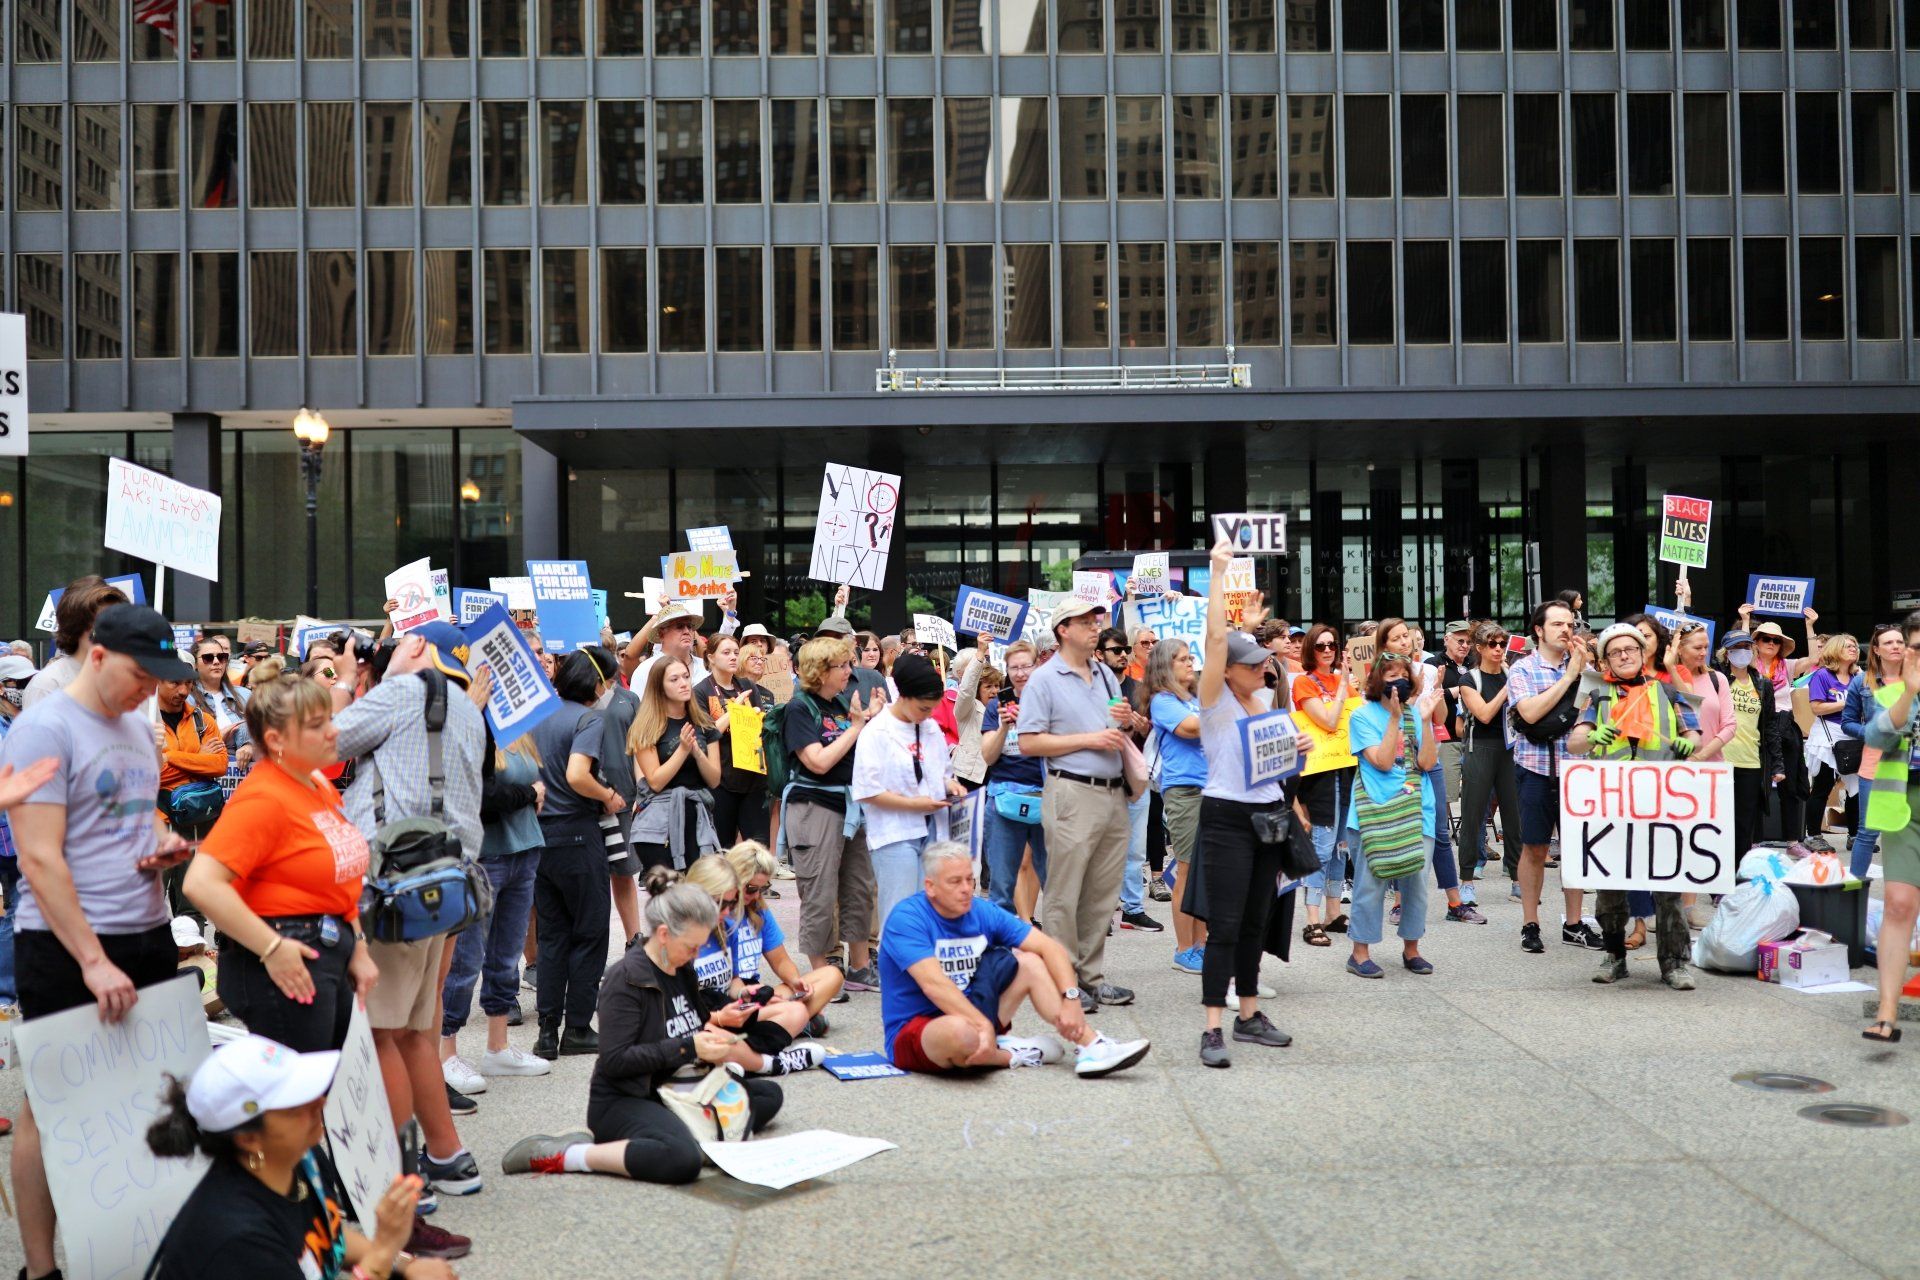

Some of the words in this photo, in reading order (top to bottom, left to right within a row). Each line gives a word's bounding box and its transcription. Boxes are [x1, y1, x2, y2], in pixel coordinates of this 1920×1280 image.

[118, 465, 163, 492] TURN
[160, 499, 200, 521] INTO
[1666, 499, 1708, 517] BLACK
[1218, 517, 1282, 549] VOTE
[1664, 518, 1708, 542] LIVES
[1662, 543, 1705, 564] MATTER
[532, 563, 578, 575] MARCH
[674, 556, 697, 579] No
[815, 543, 889, 588] NEXT
[1138, 567, 1162, 578] LIVES
[533, 575, 560, 588] FOR
[560, 575, 587, 587] OUR
[679, 580, 727, 597] Deaths
[1138, 583, 1164, 593] GUNS
[1225, 572, 1252, 588] IVE
[1760, 582, 1796, 593] MARCH
[465, 595, 495, 604] MARCH
[536, 588, 572, 600] LIVES
[1759, 591, 1780, 601] FOR
[1780, 592, 1801, 602] OUR
[465, 604, 482, 613] FOR
[970, 596, 1009, 615] MARCH
[1137, 598, 1208, 624] FUCK
[1758, 600, 1786, 610] LIVES
[965, 617, 994, 634] LIVES
[967, 606, 989, 621] FOR
[989, 612, 1012, 626] OUR
[1151, 619, 1203, 640] THE
[482, 640, 511, 677] OUR
[509, 651, 540, 699] LIVES
[503, 672, 526, 710] FOR
[1253, 721, 1289, 742] MARCH
[1256, 741, 1275, 758] FOR
[1276, 736, 1296, 754] OUR
[1257, 755, 1283, 776] LIVES
[1564, 764, 1728, 820] GHOST
[1582, 821, 1722, 885] KIDS
[696, 958, 728, 977] MARCH
[29, 1001, 188, 1105] COMMON
[52, 1081, 166, 1166] SENS
